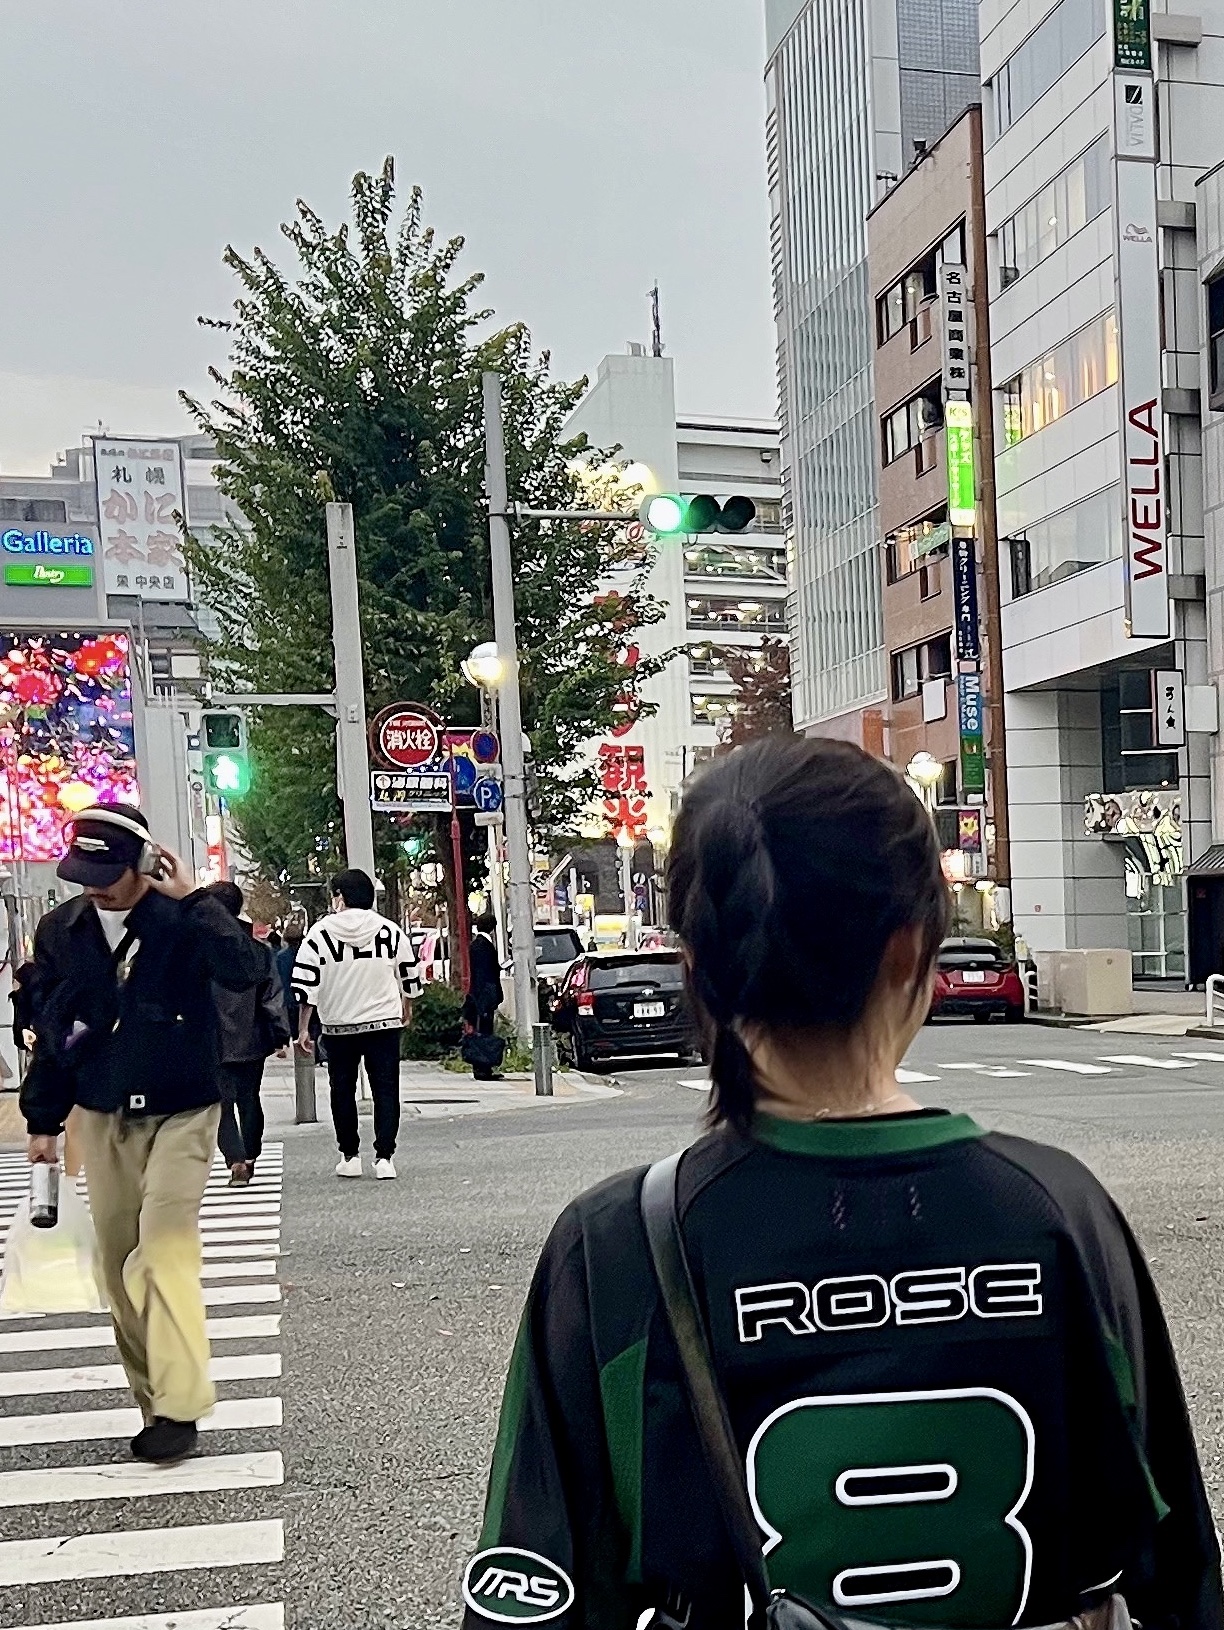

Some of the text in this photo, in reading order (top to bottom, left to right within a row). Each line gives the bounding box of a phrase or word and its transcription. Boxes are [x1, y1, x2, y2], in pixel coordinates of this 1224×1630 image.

[1123, 234, 1152, 243] WELLA
[111, 464, 165, 486] 札幌
[1128, 397, 1163, 582] WELLA
[101, 487, 177, 525] かに
[2, 528, 95, 556] Galleria
[965, 675, 980, 731] Muse
[385, 728, 433, 751] 消火栓
[480, 787, 492, 808] P
[735, 1262, 1043, 1343] ROSE
[745, 1386, 1036, 1629] 8
